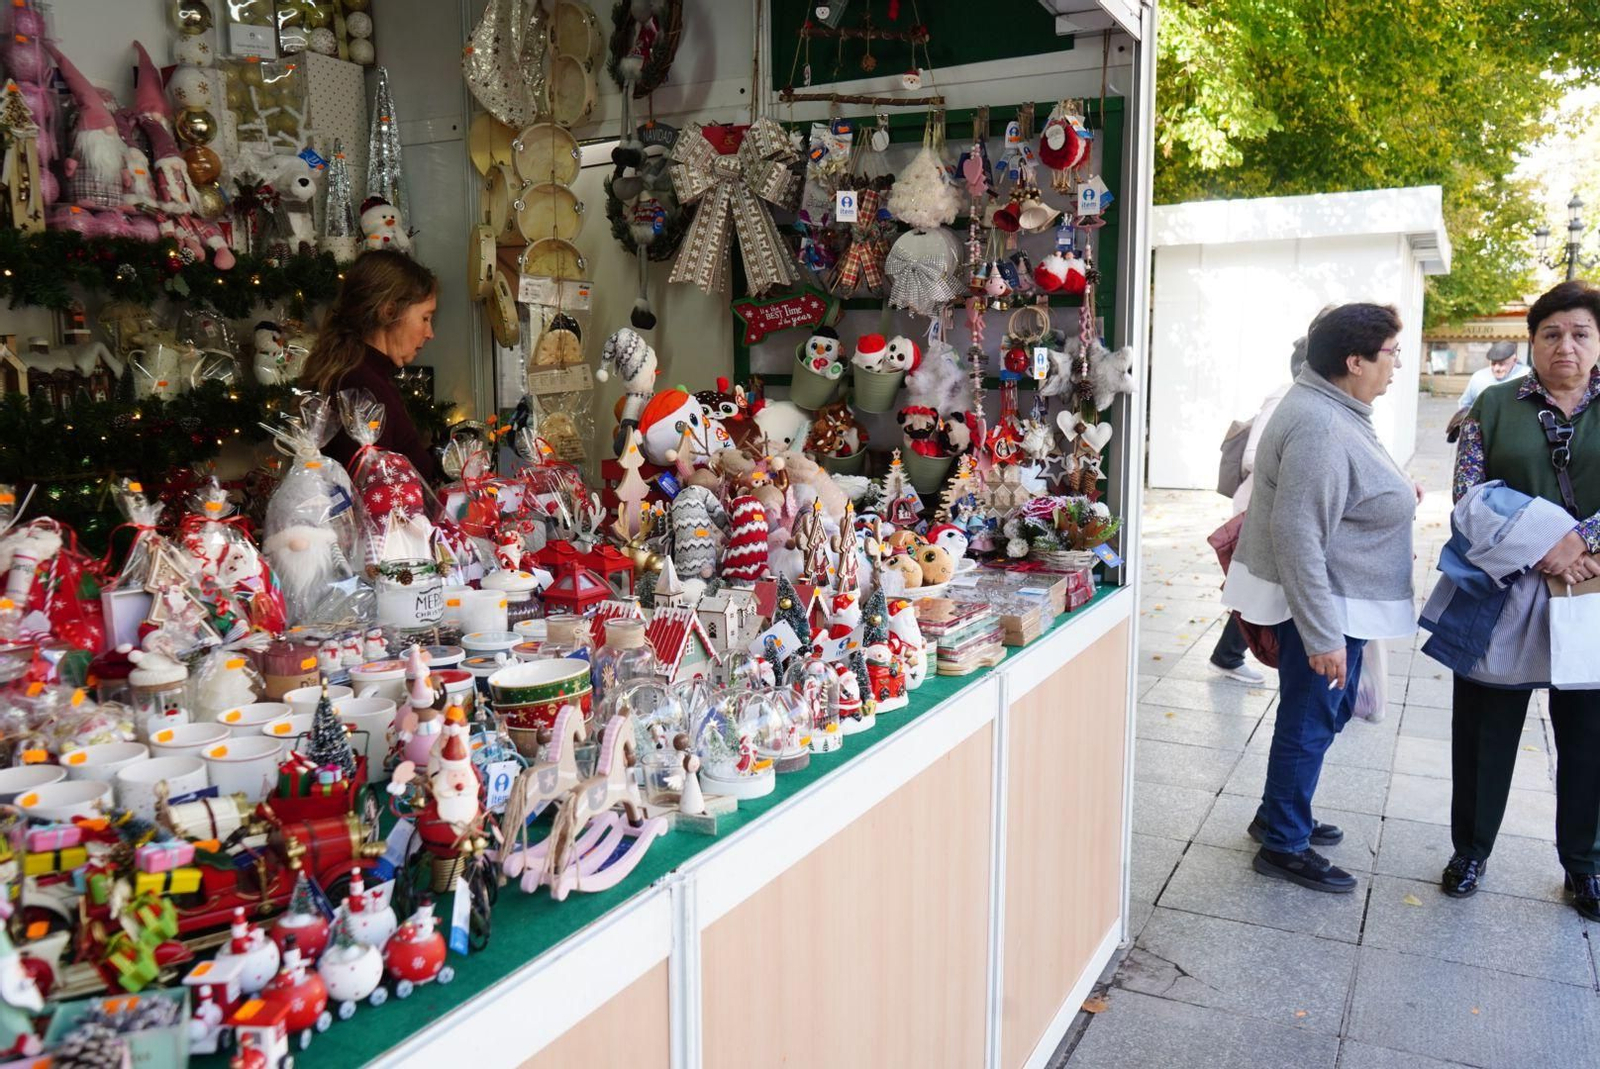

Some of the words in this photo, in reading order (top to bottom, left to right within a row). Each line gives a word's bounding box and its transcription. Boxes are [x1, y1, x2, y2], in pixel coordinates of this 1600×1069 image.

[643, 129, 673, 143] NAVIDAD
[765, 310, 783, 320] BEST
[781, 304, 803, 317] Time
[791, 313, 812, 327] year
